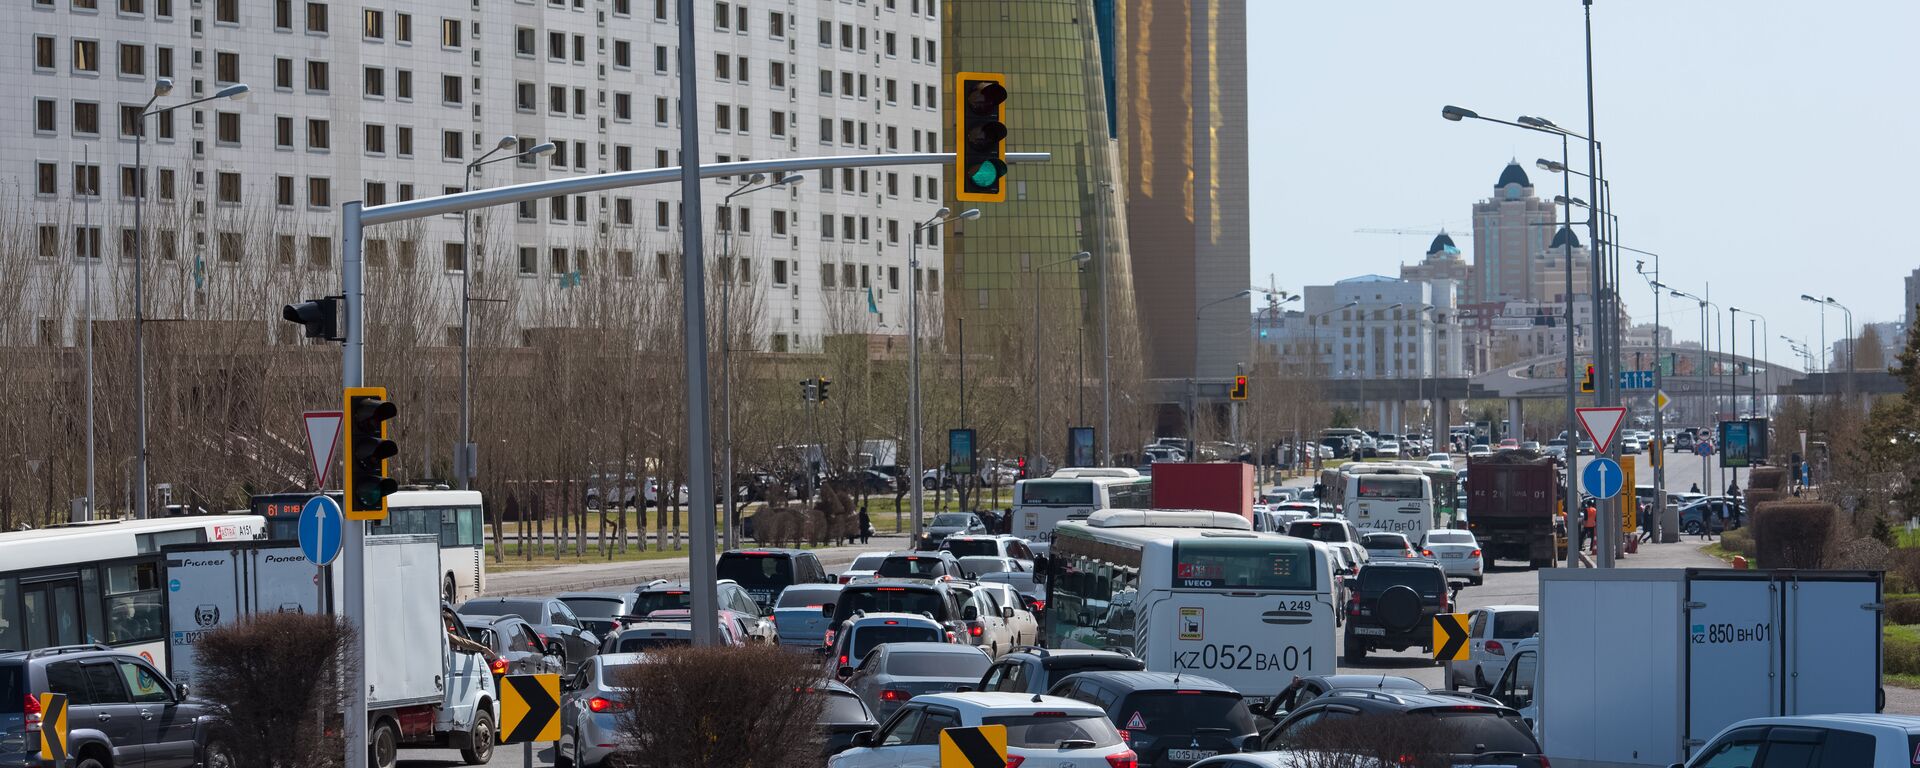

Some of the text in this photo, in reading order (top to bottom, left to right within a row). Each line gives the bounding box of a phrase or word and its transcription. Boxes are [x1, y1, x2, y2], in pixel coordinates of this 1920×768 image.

[268, 504, 278, 516] 61
[240, 526, 252, 535] A151
[184, 559, 224, 567] Pioneer
[265, 555, 306, 563] Pioneer
[1692, 634, 1705, 644] KZ
[1709, 623, 1734, 644] 850
[1755, 623, 1770, 642] 01
[1175, 750, 1190, 759] 015
